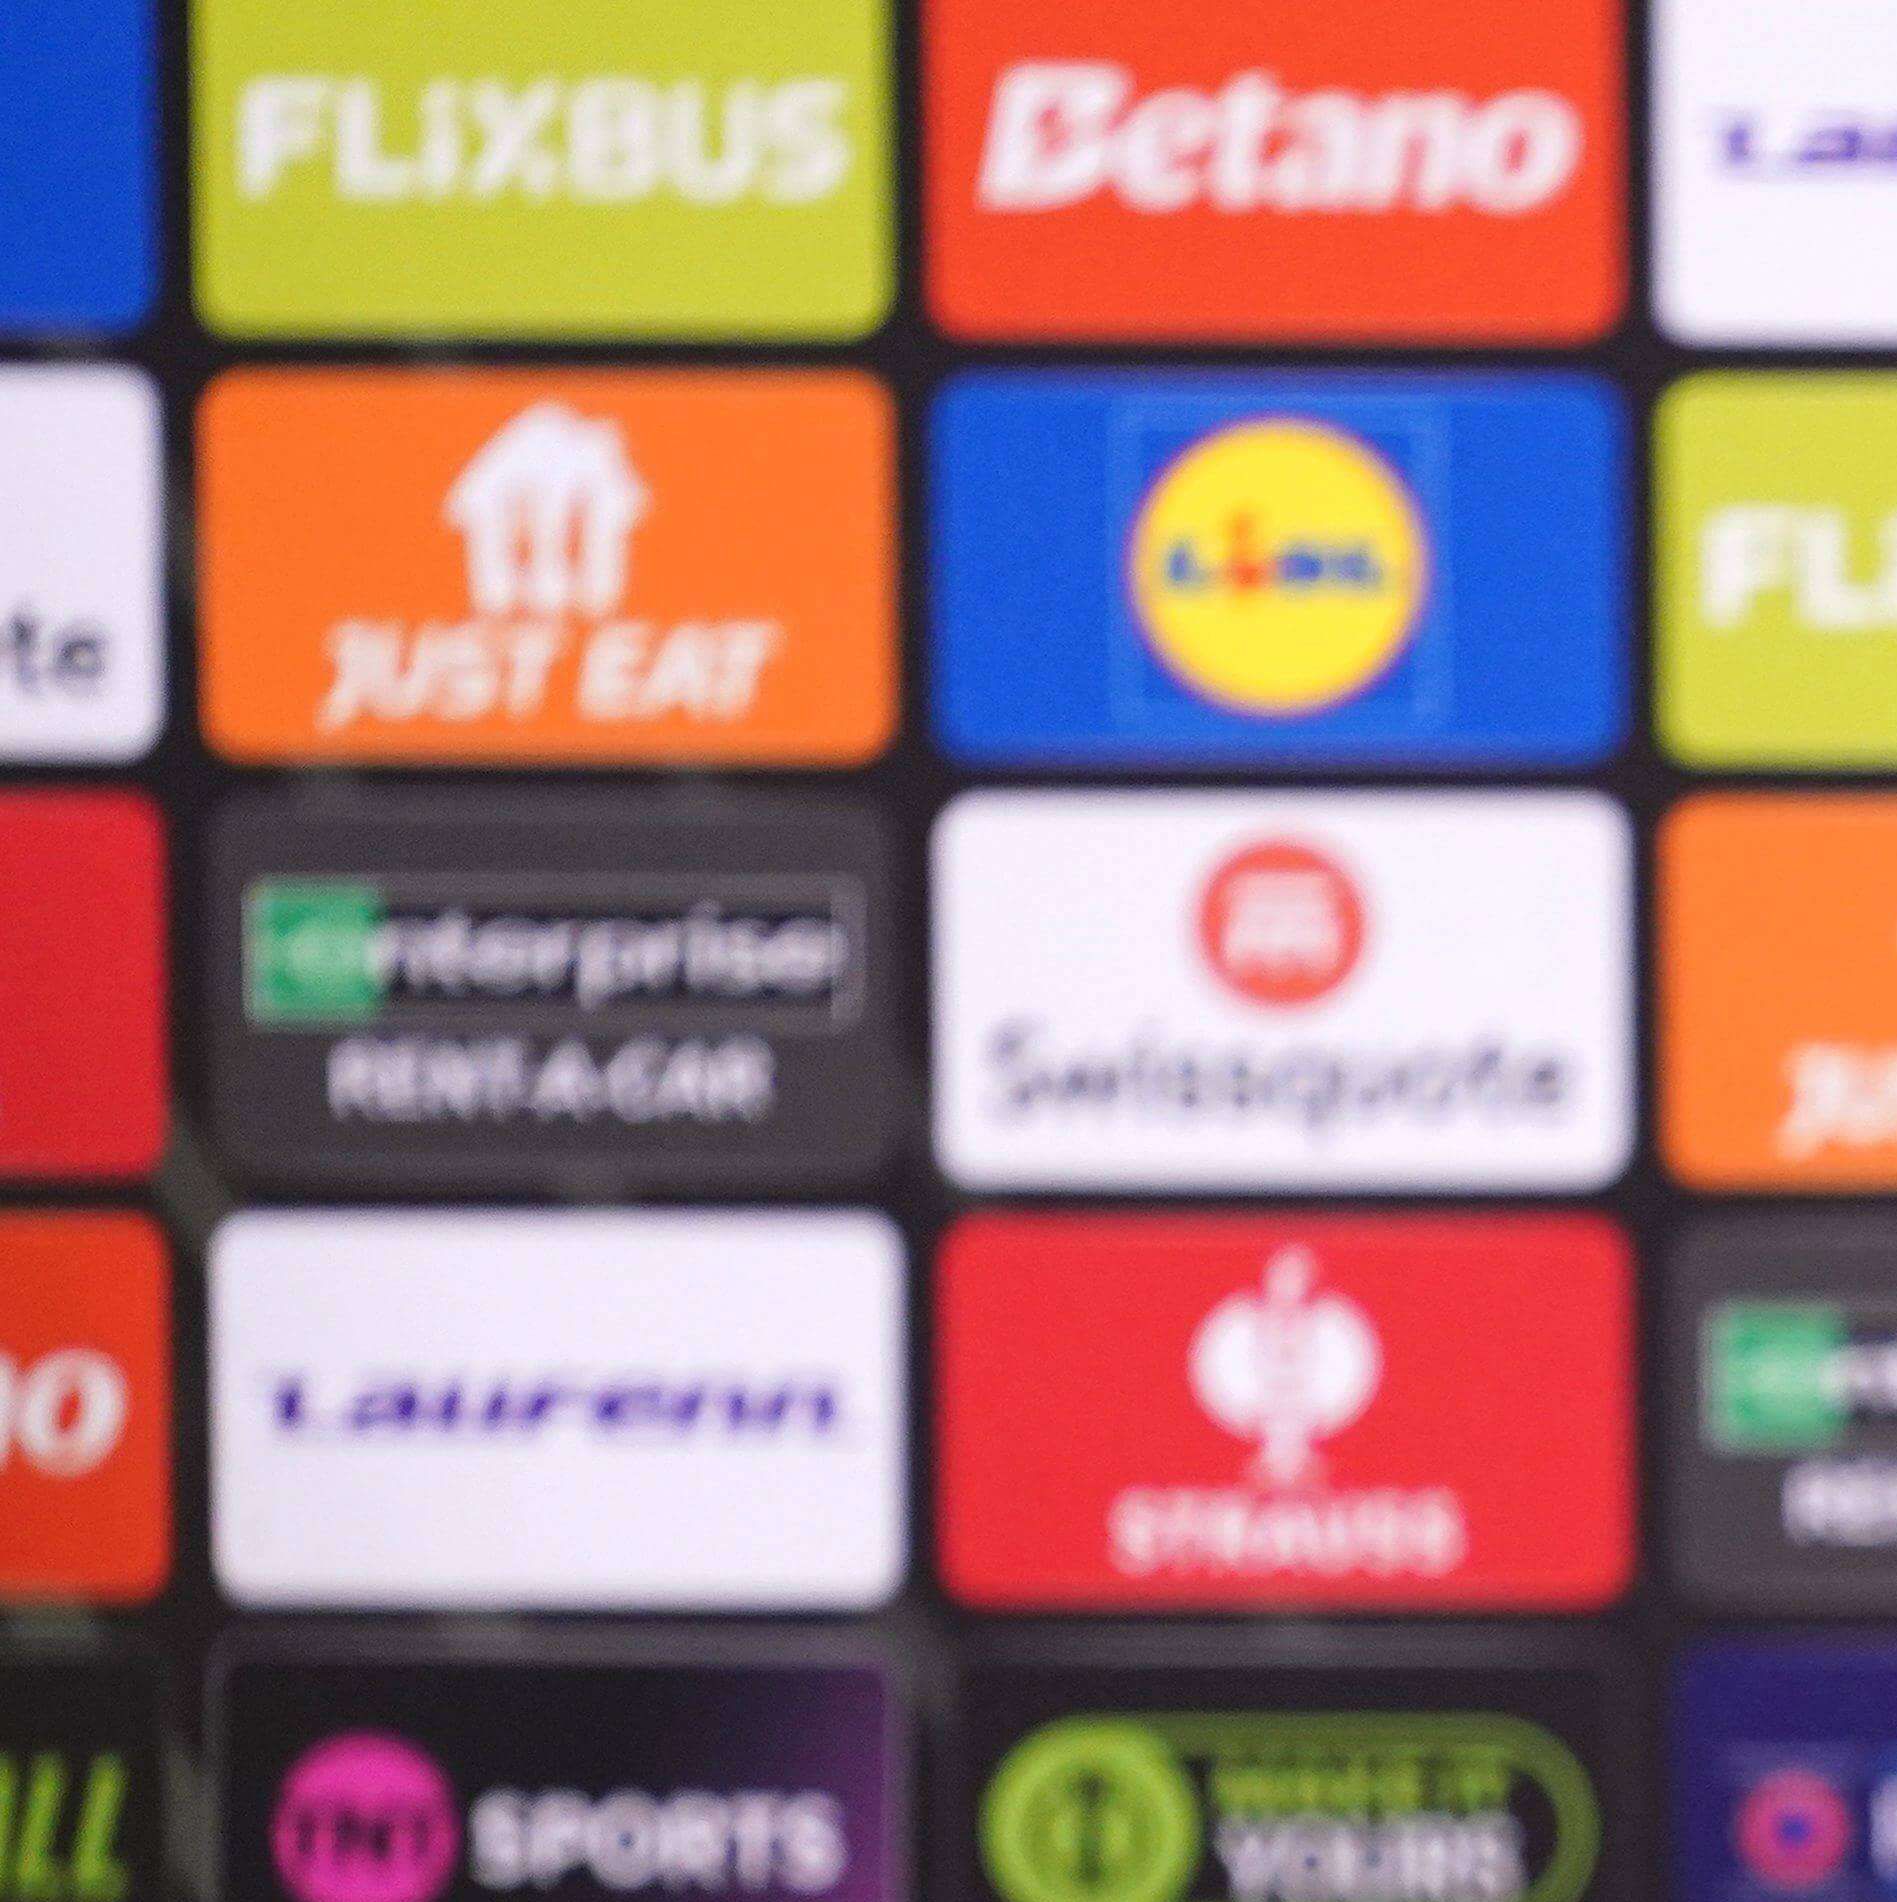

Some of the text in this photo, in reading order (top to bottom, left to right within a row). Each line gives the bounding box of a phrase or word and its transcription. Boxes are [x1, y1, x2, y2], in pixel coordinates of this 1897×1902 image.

[976, 60, 1583, 214] Betano
[317, 620, 782, 735] JUST EAT
[285, 903, 850, 1010] enterprise
[984, 1018, 1578, 1138] Swissquote
[265, 1368, 842, 1440] Laurenn
[1110, 1485, 1467, 1577] STRAUSS
[469, 1790, 850, 1897] SPORTS
